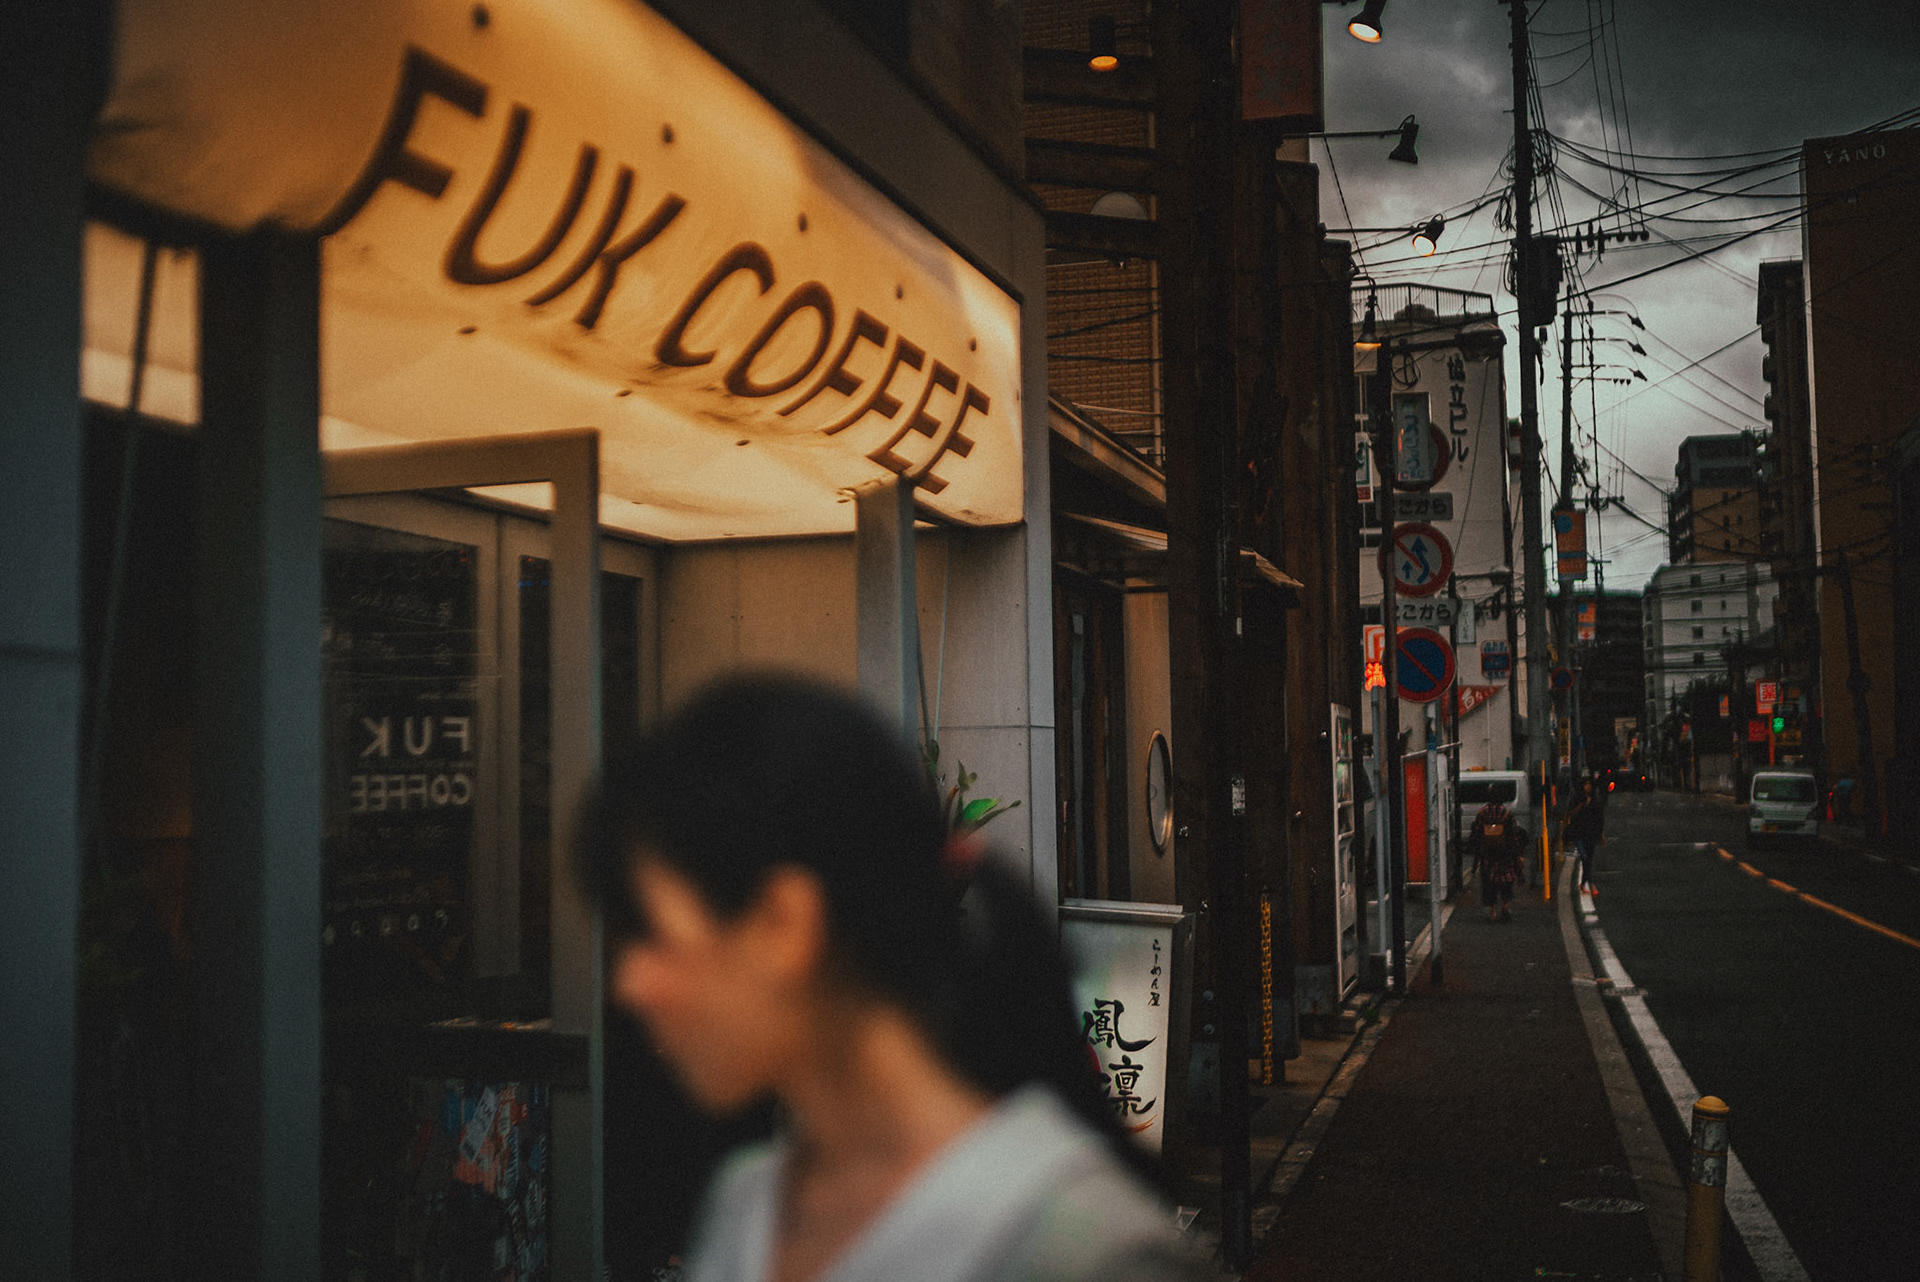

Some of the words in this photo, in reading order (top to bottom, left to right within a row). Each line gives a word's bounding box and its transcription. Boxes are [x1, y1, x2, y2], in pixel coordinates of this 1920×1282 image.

[1823, 143, 1888, 165] YANO
[318, 45, 688, 329] FUK
[654, 241, 991, 494] COFFEE
[1393, 497, 1448, 516] こから
[1148, 938, 1163, 1007] らーめん屋
